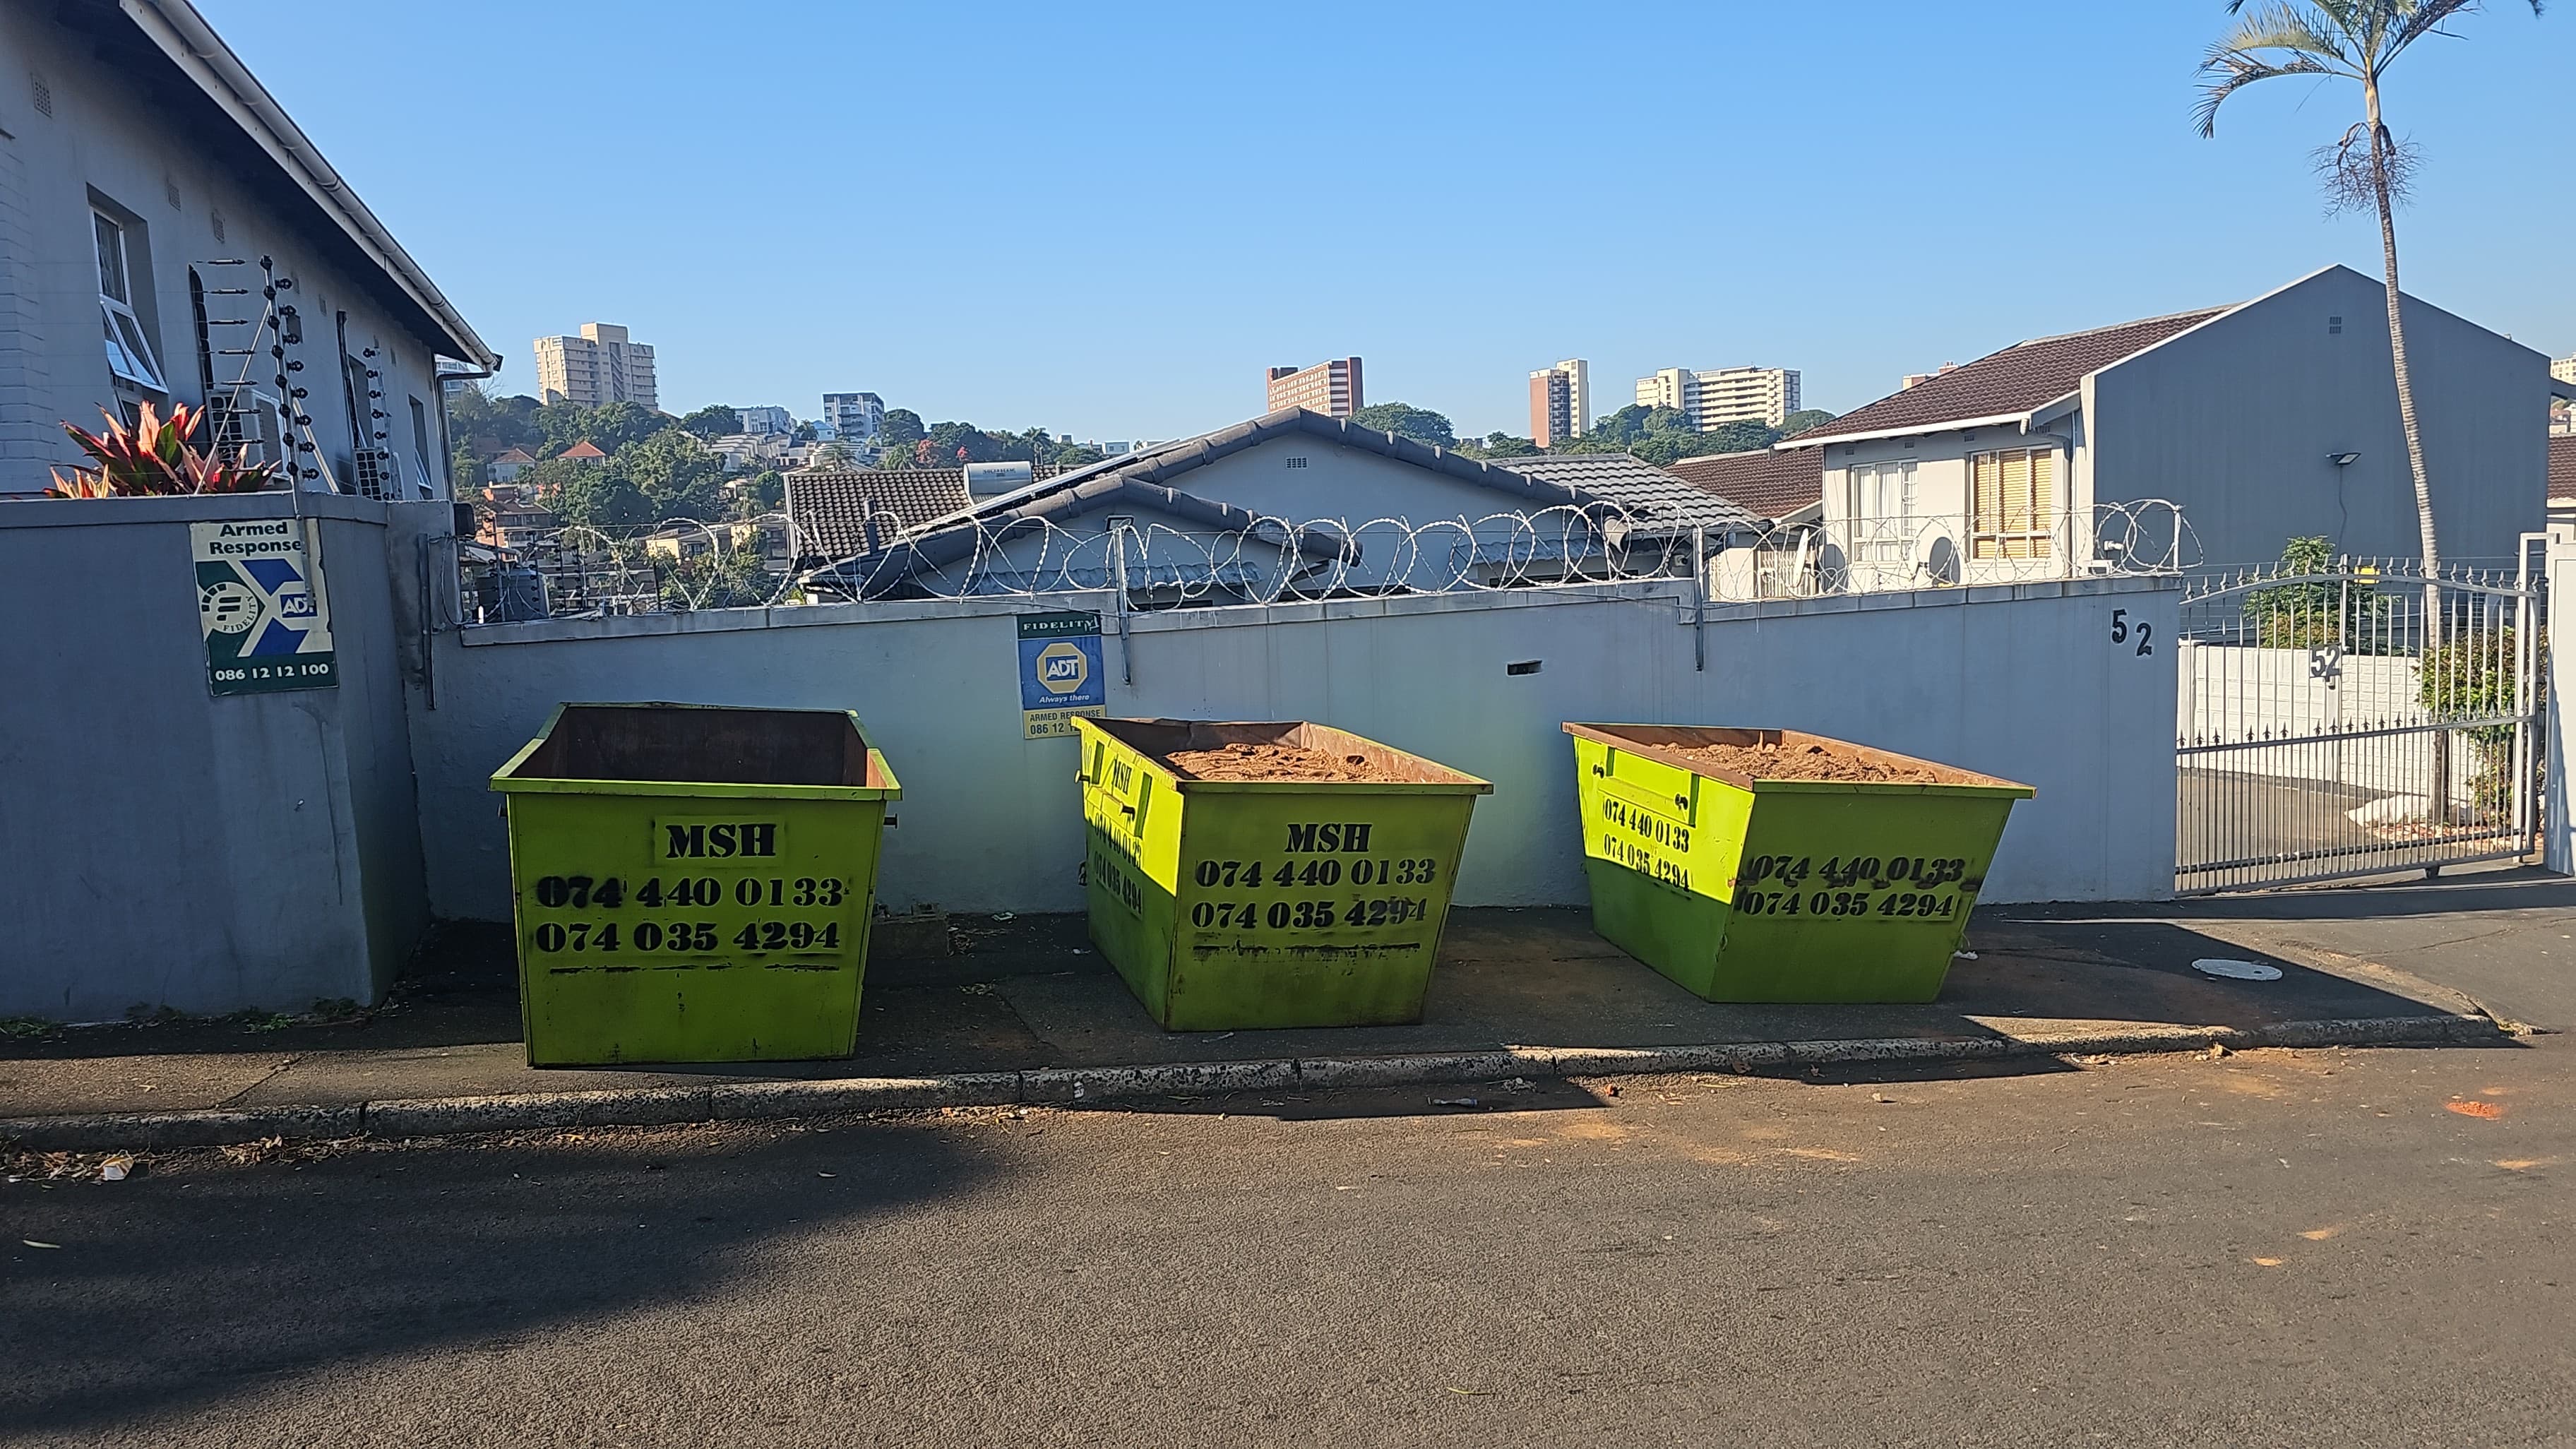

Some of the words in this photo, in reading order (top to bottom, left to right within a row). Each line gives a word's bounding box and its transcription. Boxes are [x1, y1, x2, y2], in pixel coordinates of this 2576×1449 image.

[220, 522, 288, 537] Armed
[210, 540, 301, 556] Response
[223, 595, 256, 631] FIDELITY
[1024, 619, 1094, 631] FIDELITY
[215, 669, 246, 681] 086
[252, 667, 270, 679] 12
[277, 666, 295, 677] 12
[302, 664, 329, 675] 100
[1046, 659, 1079, 677] ADT
[2311, 645, 2340, 678] 52
[1039, 696, 1068, 704] Always
[1030, 712, 1058, 722] ARMED
[1061, 709, 1101, 720] RESPONSE
[1030, 724, 1049, 735] 086
[1052, 722, 1064, 733] 12
[1112, 758, 1133, 796] MSH
[666, 823, 777, 859] MSH
[1284, 823, 1373, 853] MSH
[1604, 799, 1626, 827] 074
[1629, 809, 1652, 837] 440
[1656, 820, 1690, 853] 0133
[1195, 860, 1262, 888] 074
[1272, 859, 1342, 887] 440
[1350, 858, 1436, 886] 0133
[1604, 834, 1624, 861] 074
[1628, 844, 1650, 876] 035
[1654, 858, 1690, 893] 4294
[1753, 855, 1810, 880] 074
[1819, 857, 1880, 881] 440
[1887, 857, 1965, 881] 0133
[537, 876, 623, 908] 074
[636, 878, 722, 907] 440
[735, 877, 843, 907] 0133
[1743, 893, 1800, 916] 074
[1809, 892, 1870, 916] 035
[1877, 893, 1954, 917] 4294
[1192, 902, 1257, 929] 074
[1267, 901, 1335, 929] 035
[1344, 898, 1426, 926] 4294
[537, 922, 621, 952] 074
[634, 922, 718, 951] 035
[734, 922, 840, 950] 4294
